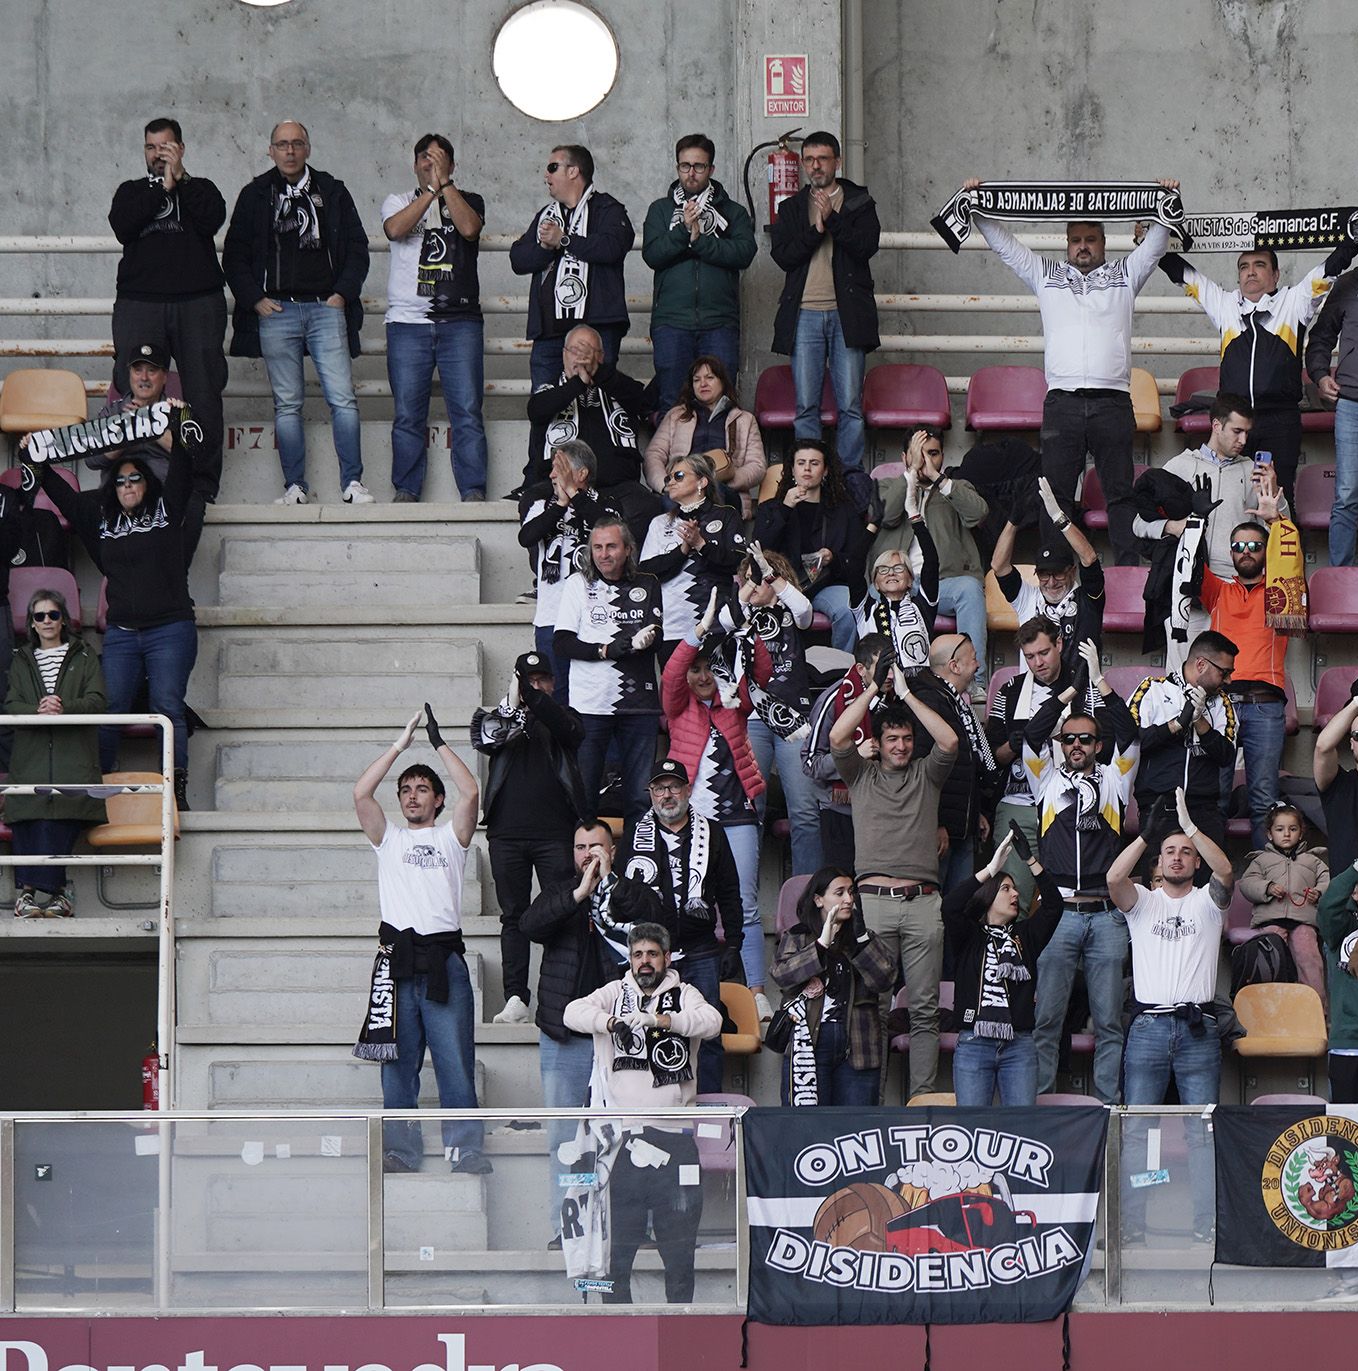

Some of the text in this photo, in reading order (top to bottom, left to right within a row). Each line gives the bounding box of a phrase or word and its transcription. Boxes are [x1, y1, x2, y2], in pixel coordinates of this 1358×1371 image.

[768, 101, 804, 112] EXTINTOR
[1235, 219, 1250, 235] de
[1250, 215, 1318, 236] Salamanca
[1319, 212, 1341, 230] C.F.
[28, 401, 172, 463] UNIONISTAS
[630, 609, 644, 619] QR
[794, 1124, 1054, 1188] ON TOUR
[1262, 1178, 1280, 1190] 20
[765, 1227, 1083, 1293] DISIDENCIA
